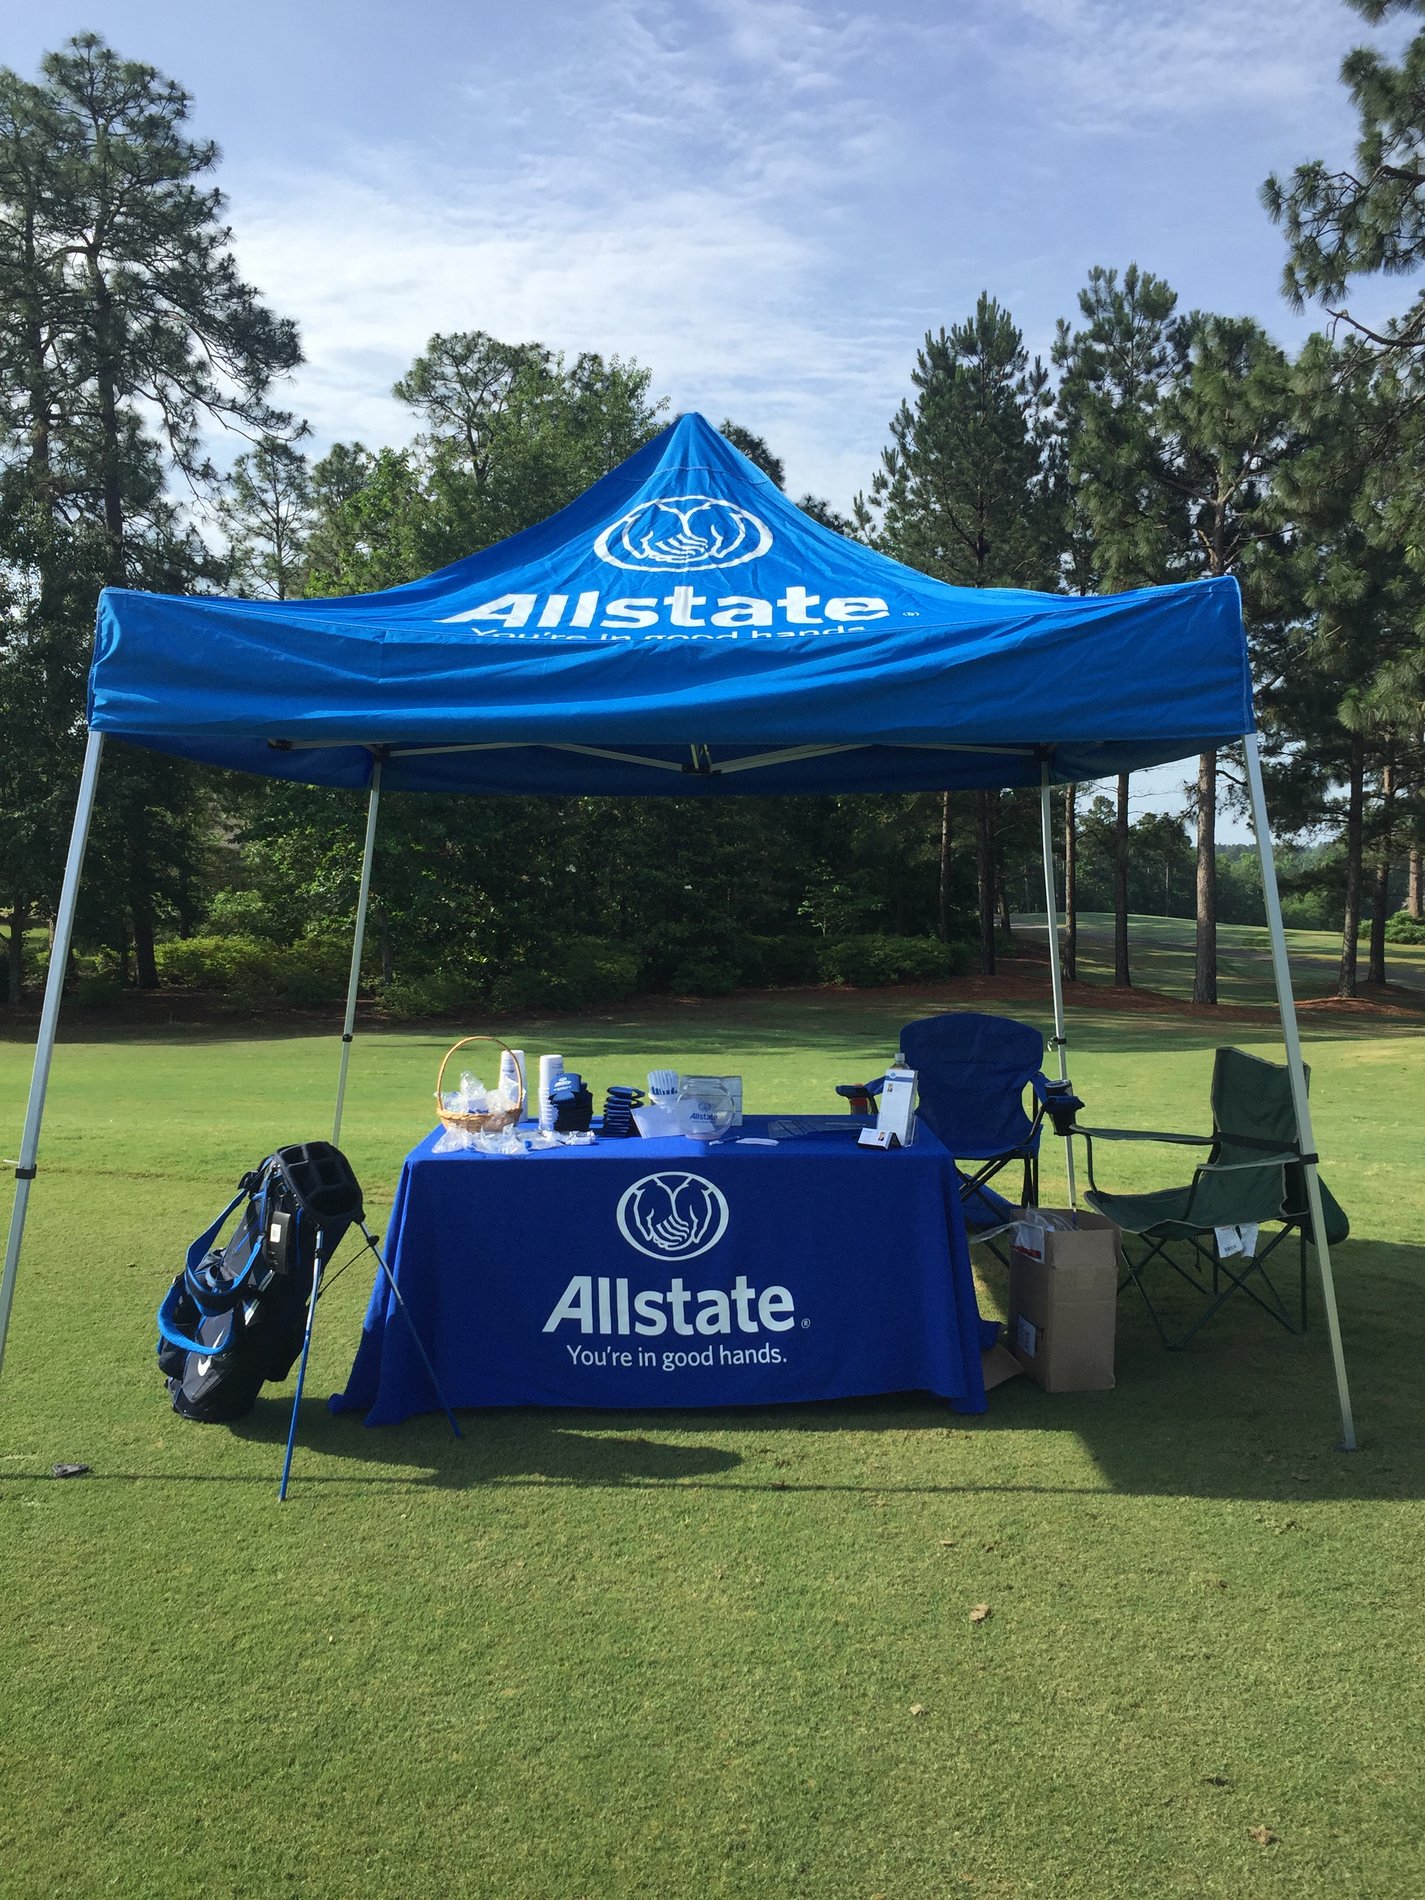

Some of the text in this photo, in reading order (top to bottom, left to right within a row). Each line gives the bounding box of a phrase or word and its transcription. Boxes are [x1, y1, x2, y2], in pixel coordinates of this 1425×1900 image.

[433, 585, 890, 629] Allstate
[541, 1275, 796, 1337] Allstate
[566, 1342, 788, 1372] You're in good hands.
